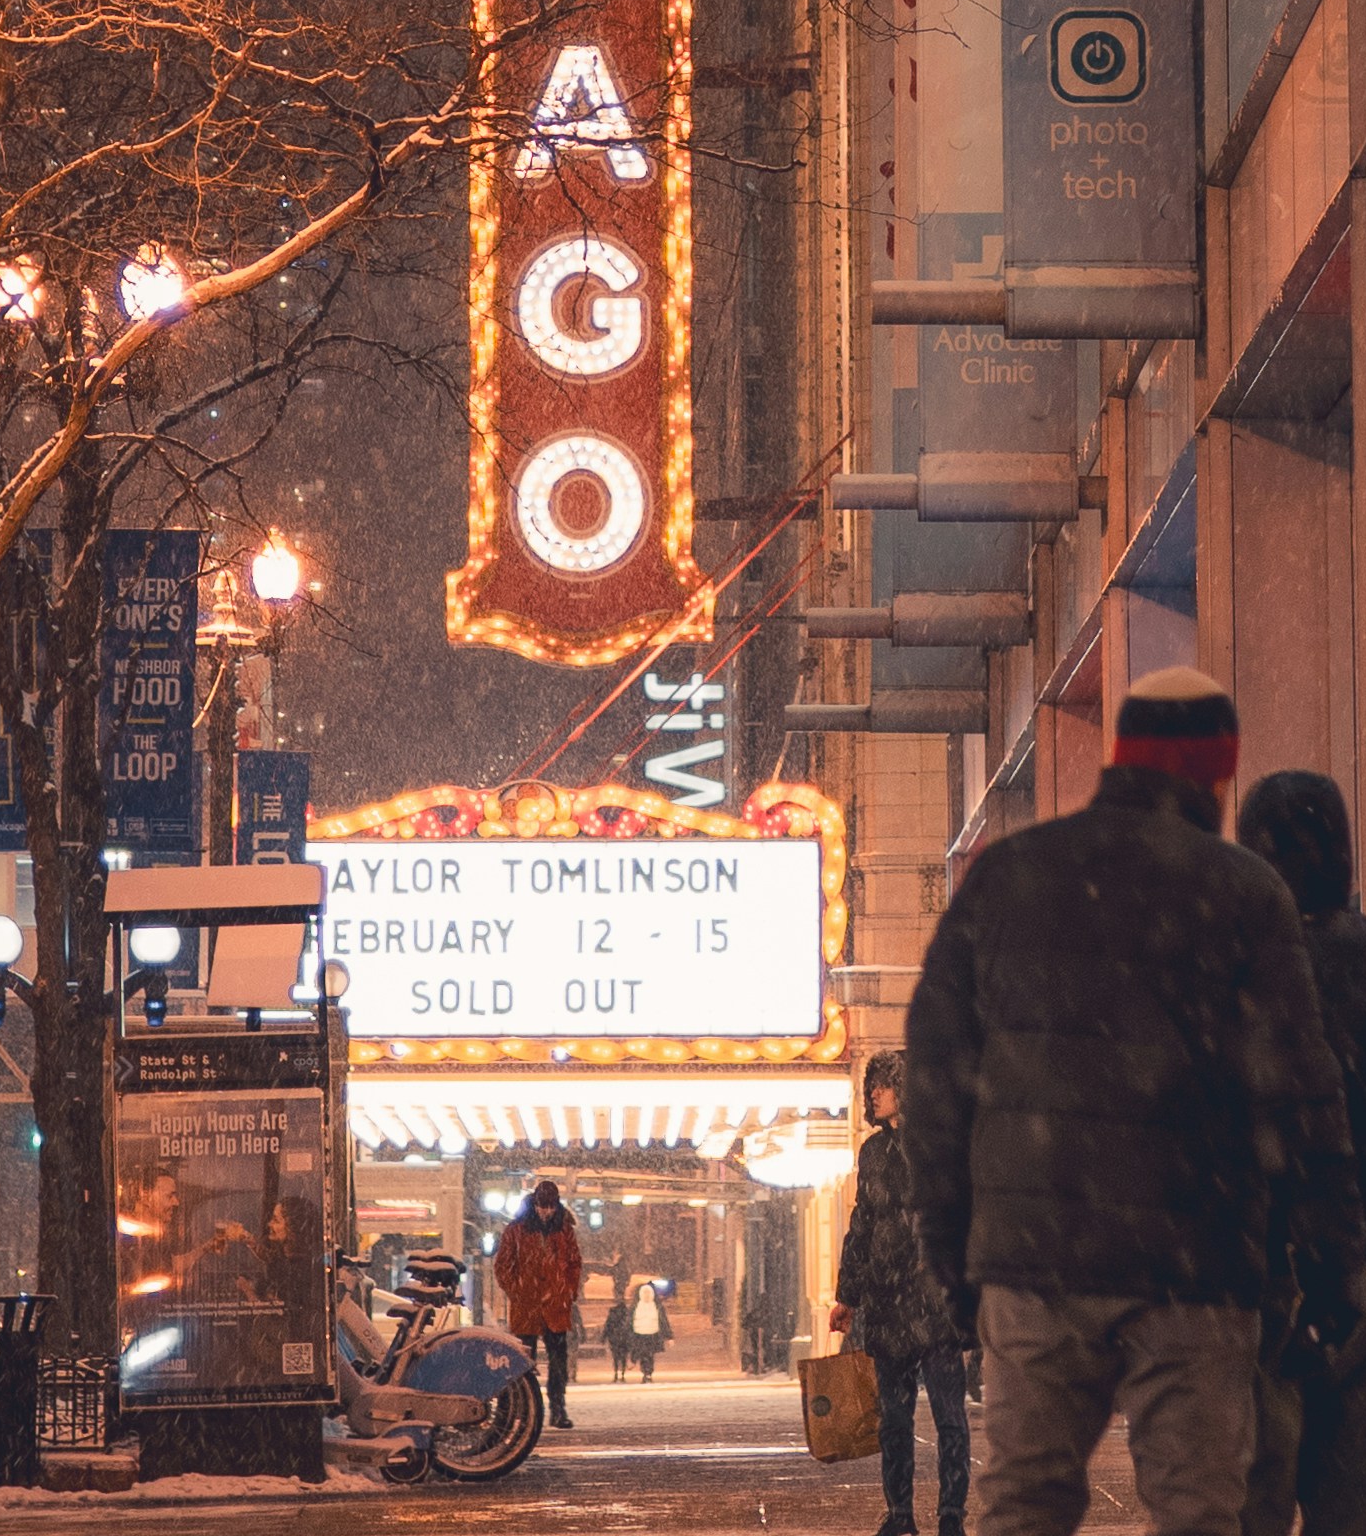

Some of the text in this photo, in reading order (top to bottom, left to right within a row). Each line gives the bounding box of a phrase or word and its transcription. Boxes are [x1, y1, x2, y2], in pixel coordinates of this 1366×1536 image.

[1049, 115, 1148, 152] photo
[1062, 169, 1138, 201] tech
[960, 356, 1036, 384] Clinic
[115, 604, 183, 631] ONE'S
[113, 677, 182, 706] HOOD
[132, 734, 158, 750] THE
[113, 751, 178, 782] LOOP
[261, 792, 283, 823] THE
[307, 857, 739, 895] AYLOR TOMLINSON
[575, 919, 614, 954] 12
[694, 918, 730, 954] 15
[410, 979, 643, 1016] SOLD OUT
[139, 1054, 210, 1067] State St &
[139, 1068, 217, 1082] Randolph St
[150, 1108, 288, 1136] Happy Hours Are
[160, 1133, 280, 1158] Better Up Here
